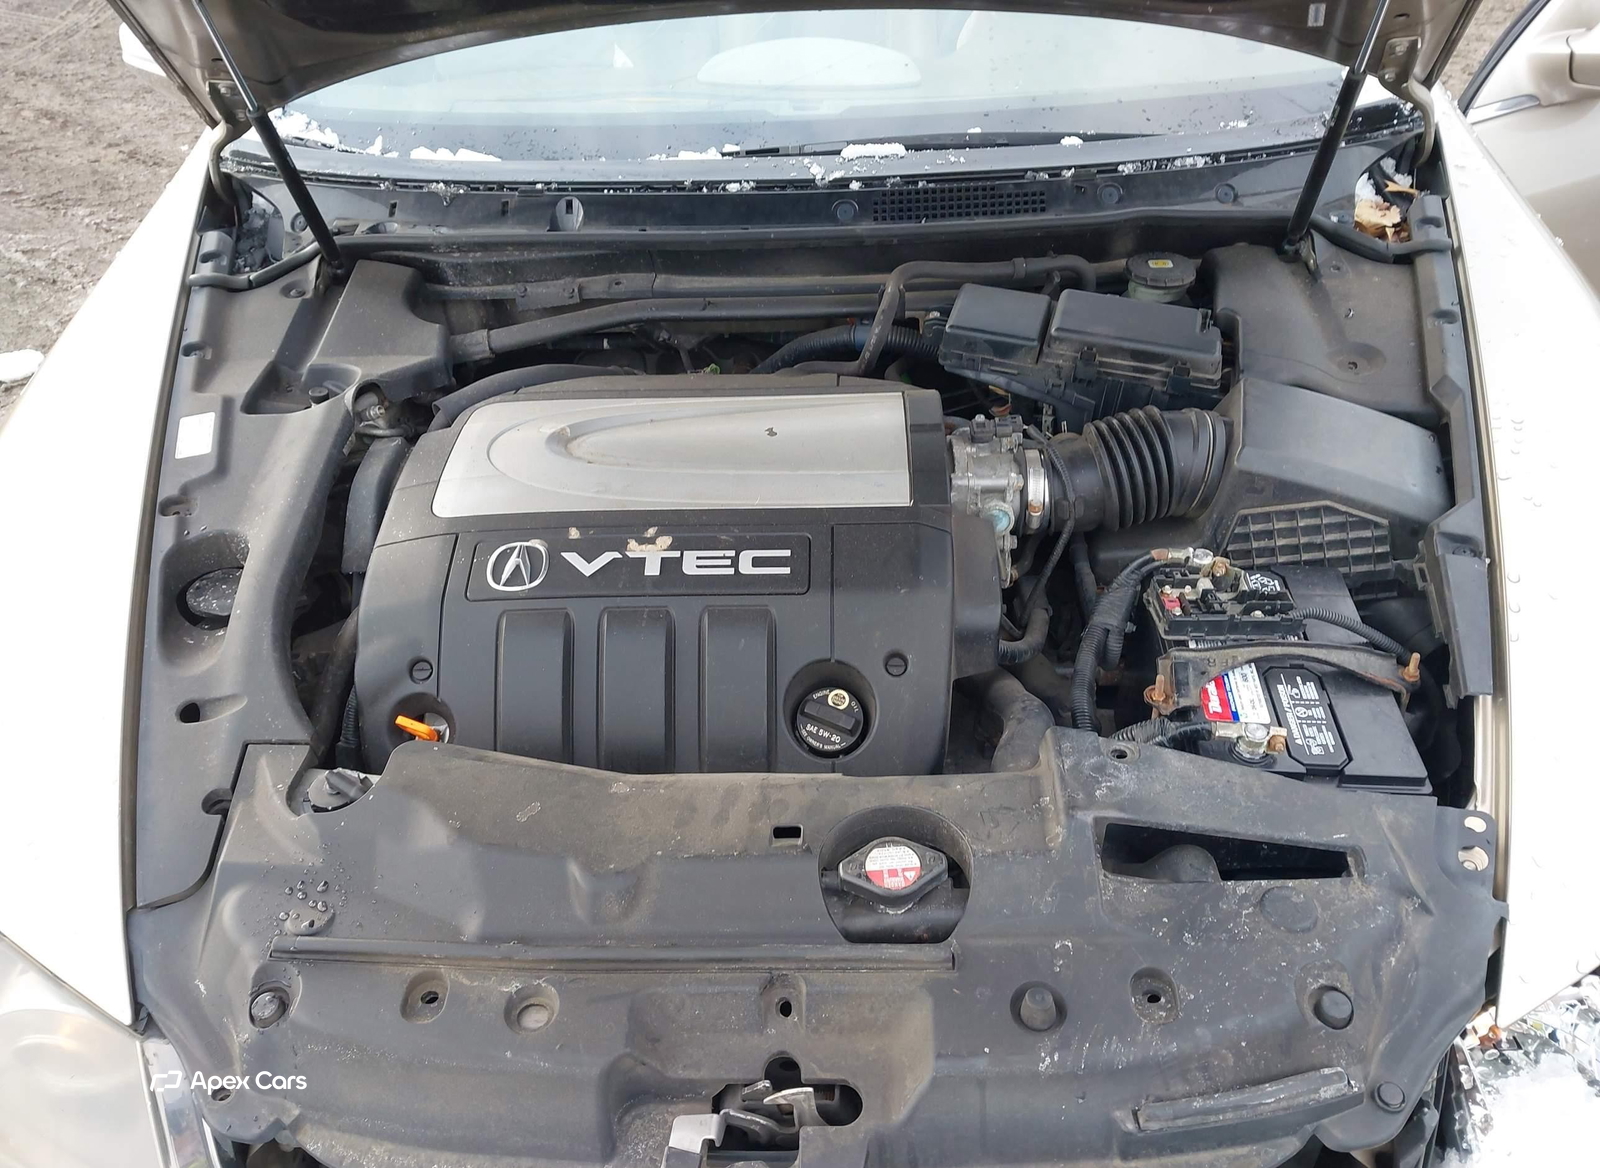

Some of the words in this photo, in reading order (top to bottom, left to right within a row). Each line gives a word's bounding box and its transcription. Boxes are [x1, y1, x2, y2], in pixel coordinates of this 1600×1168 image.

[560, 548, 792, 578] VTEC
[850, 701, 859, 713] OIL
[805, 723, 819, 734] SAE
[818, 727, 841, 743] 5W-20
